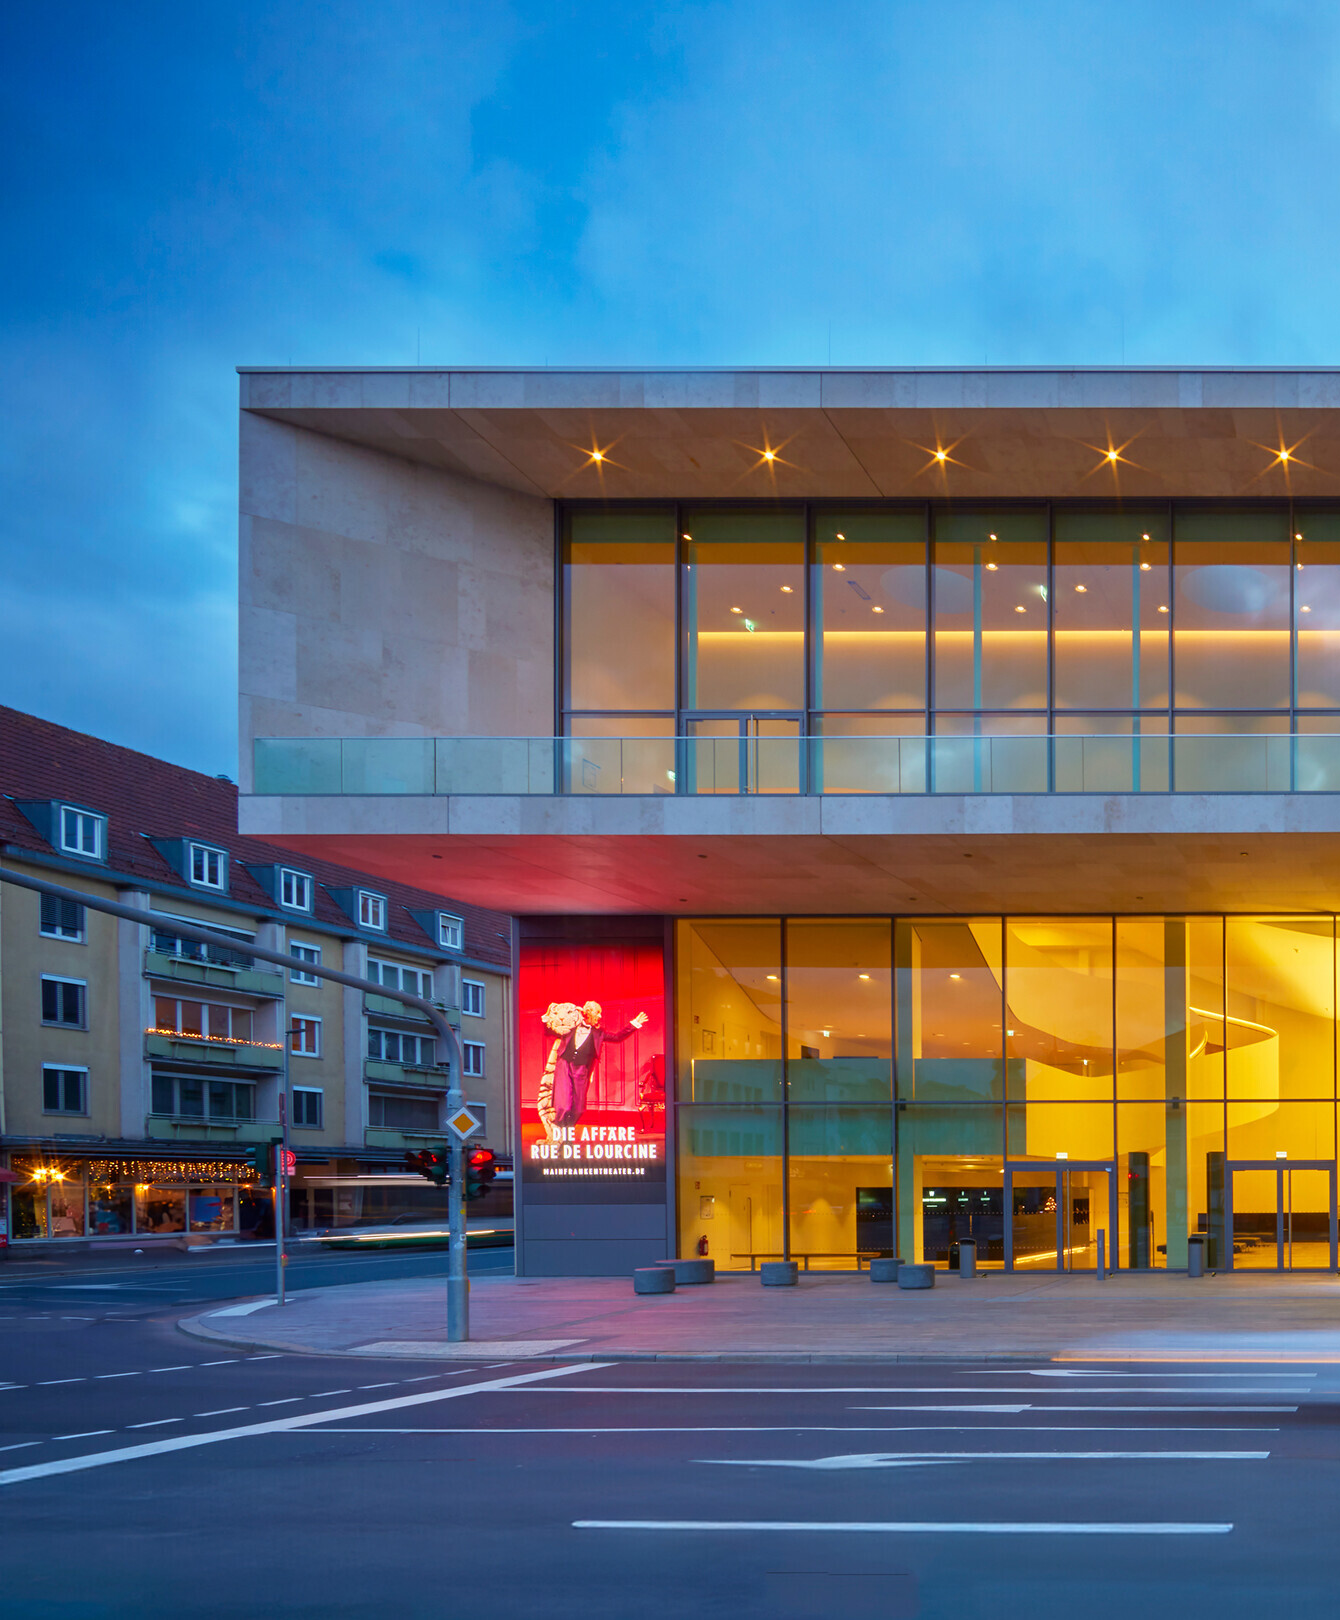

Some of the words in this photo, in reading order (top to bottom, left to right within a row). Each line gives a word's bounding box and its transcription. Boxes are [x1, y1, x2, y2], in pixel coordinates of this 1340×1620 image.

[552, 1126, 576, 1141] DIE
[580, 1126, 636, 1141] AFFÄRE
[530, 1144, 559, 1159] RUE
[563, 1144, 581, 1159] DE
[586, 1144, 657, 1159] LOURCINE
[543, 1167, 645, 1176] MAINFRANKENTHEATER.DE
